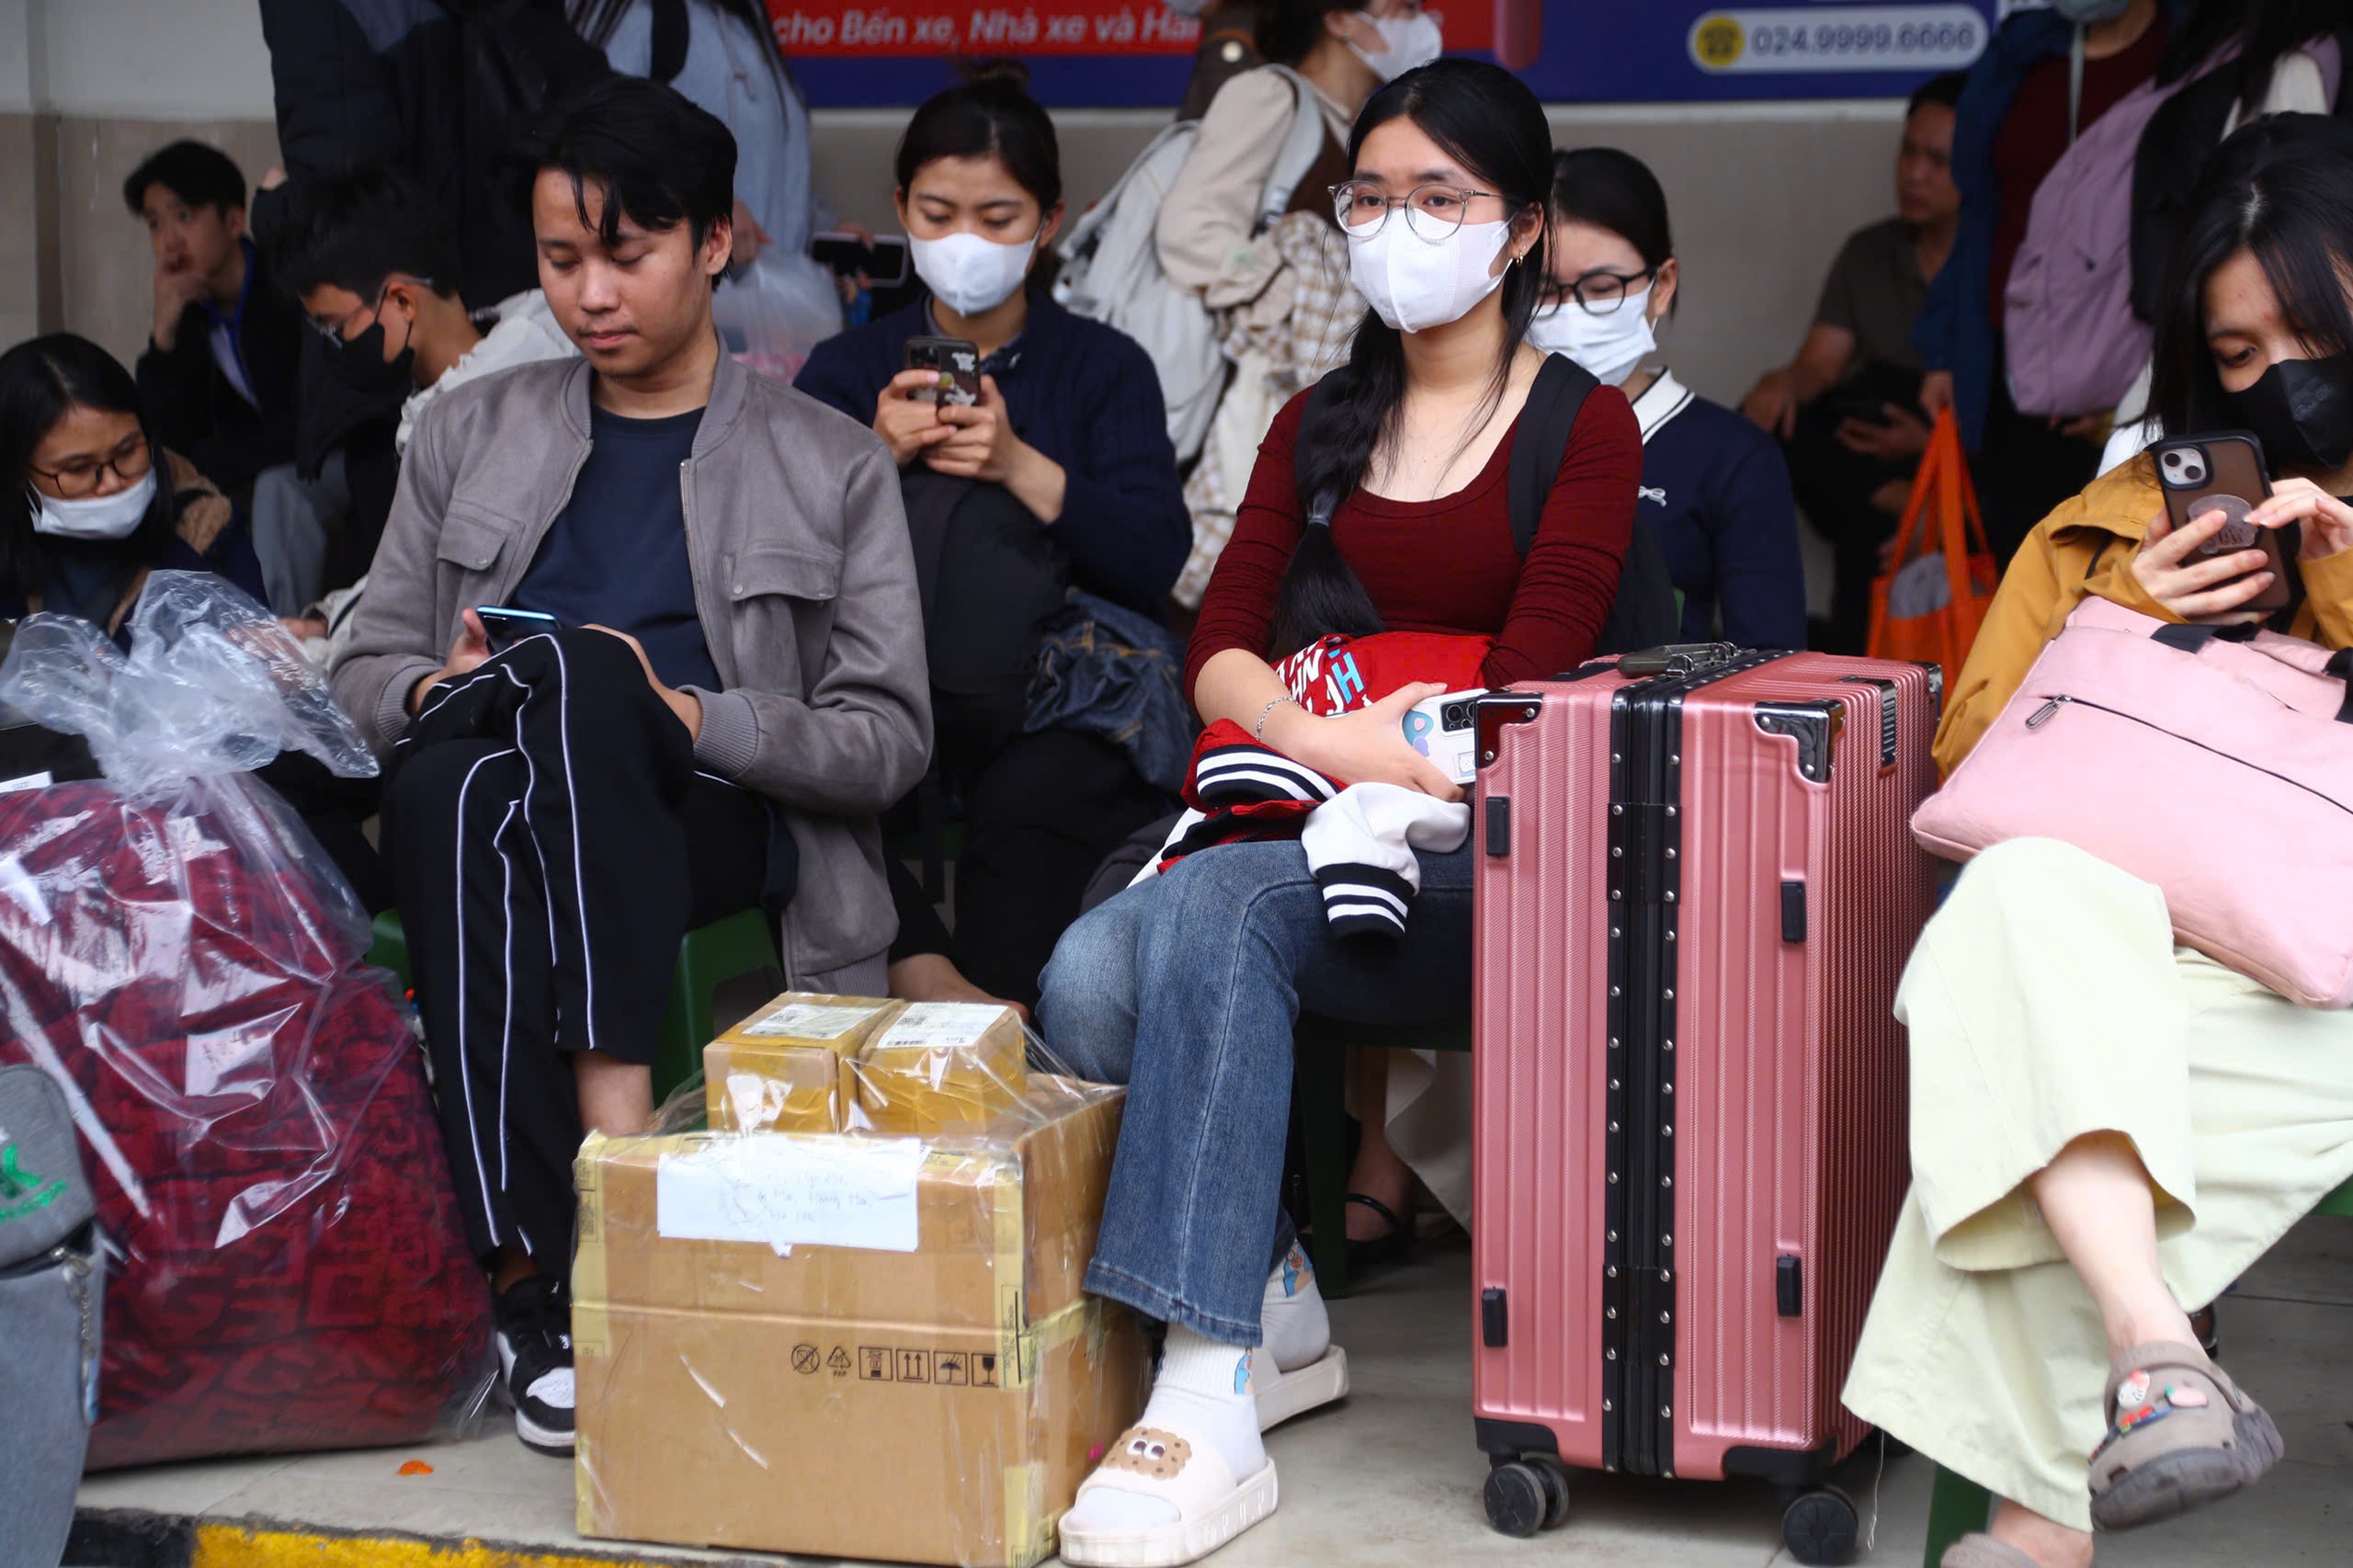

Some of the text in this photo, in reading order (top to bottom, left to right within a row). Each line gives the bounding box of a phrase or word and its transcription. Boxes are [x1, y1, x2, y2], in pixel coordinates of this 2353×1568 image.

[773, 10, 834, 45] cho
[840, 7, 908, 45] Bến
[1045, 15, 1088, 43] xe
[1096, 7, 1136, 44] và
[1751, 20, 1976, 57] 024.9999.6666
